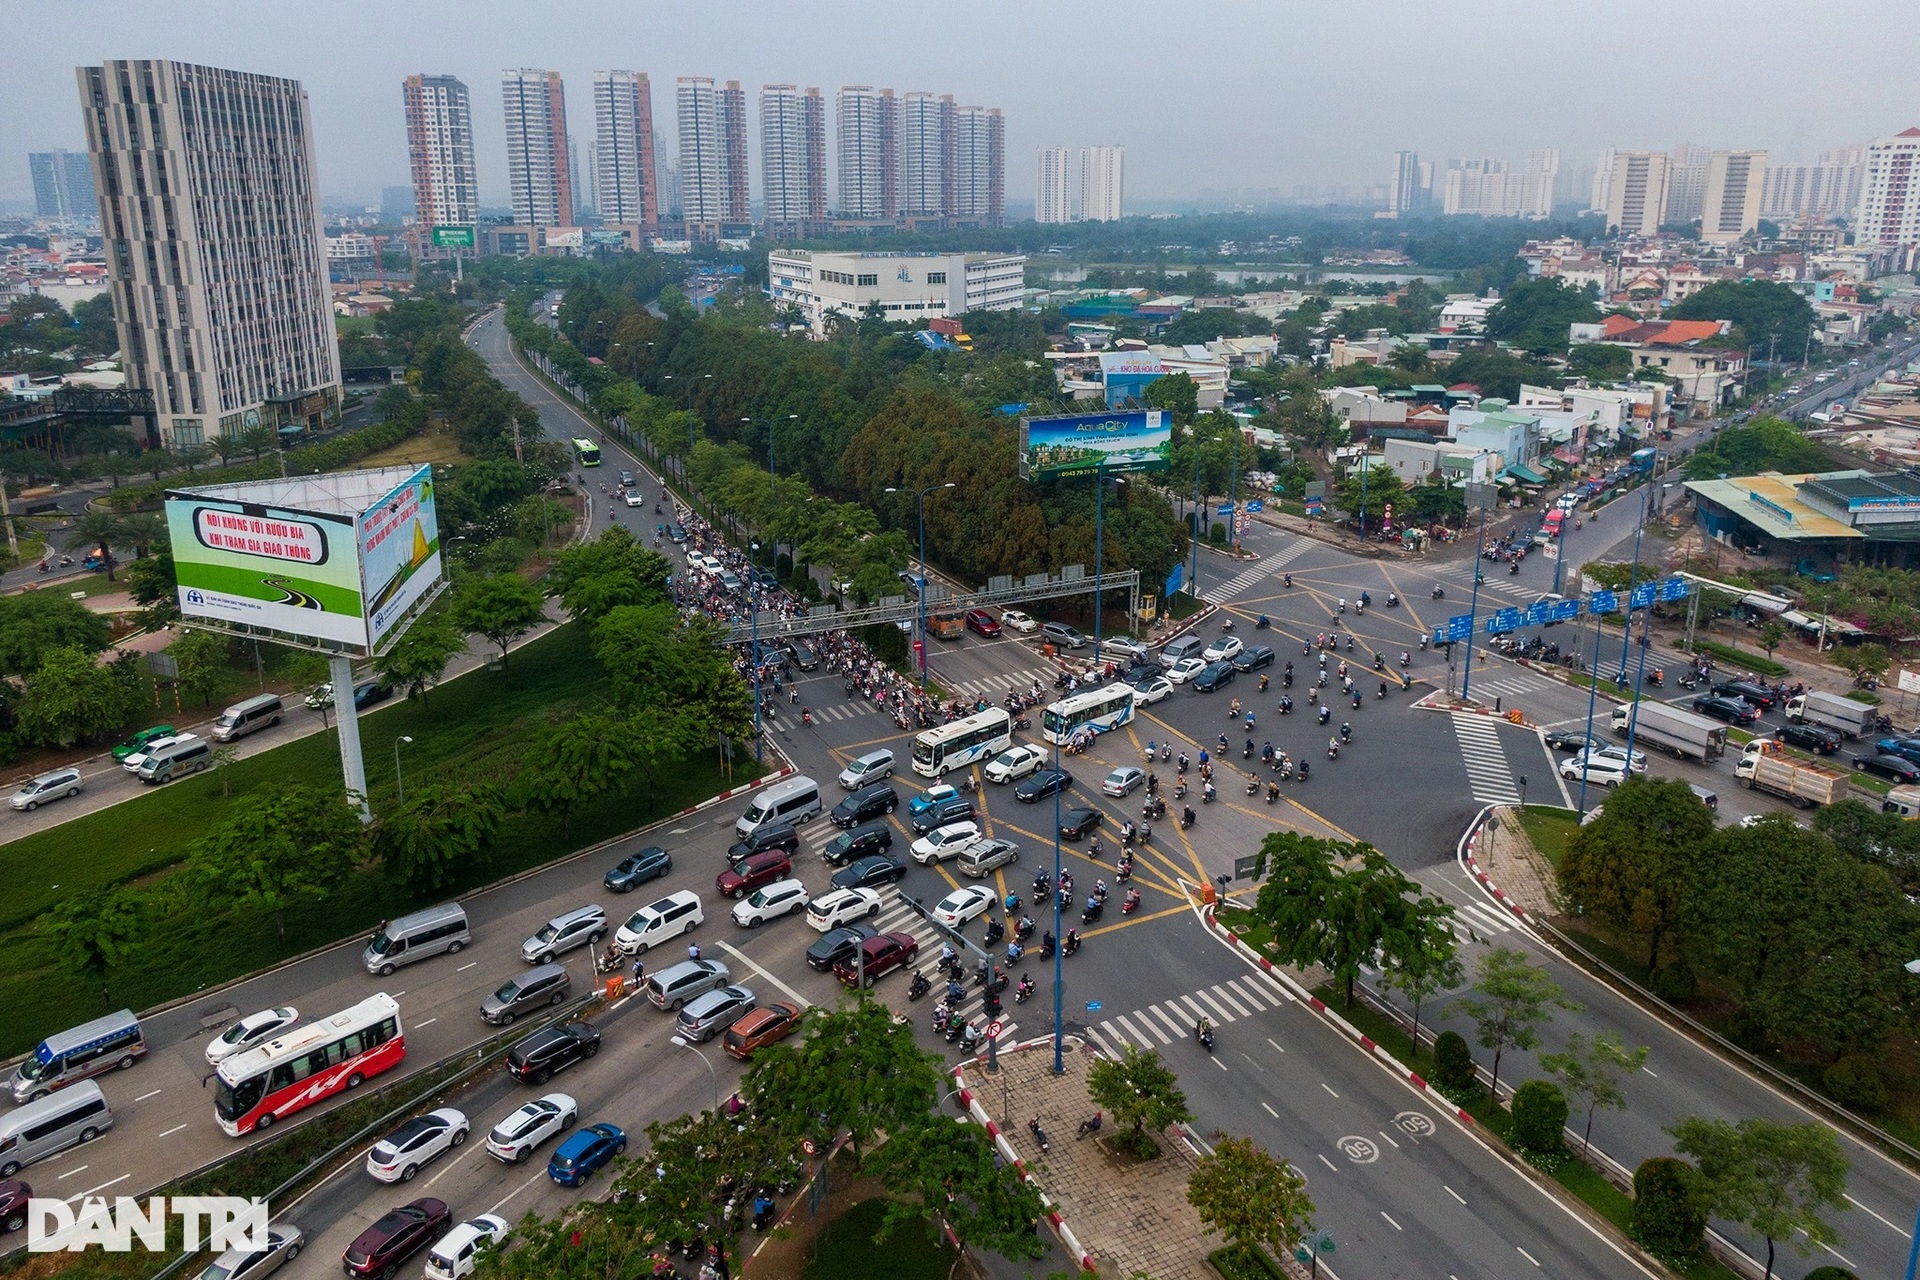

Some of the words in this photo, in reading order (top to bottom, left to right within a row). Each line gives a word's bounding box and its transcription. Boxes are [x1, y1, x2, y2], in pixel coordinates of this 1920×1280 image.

[1076, 420, 1128, 432] AquaCity
[206, 512, 220, 526] NÓI
[222, 515, 248, 531] KHÔNG
[250, 519, 264, 534] VỚI
[266, 522, 288, 539] RƯỢU
[290, 527, 304, 540] BIA
[209, 533, 222, 545] KHI
[224, 535, 246, 550] THAM
[248, 539, 261, 552] GIA
[264, 542, 282, 555] GIAO
[285, 544, 311, 560] THÔNG
[1402, 1116, 1429, 1132] 50
[1345, 1141, 1373, 1158] 50
